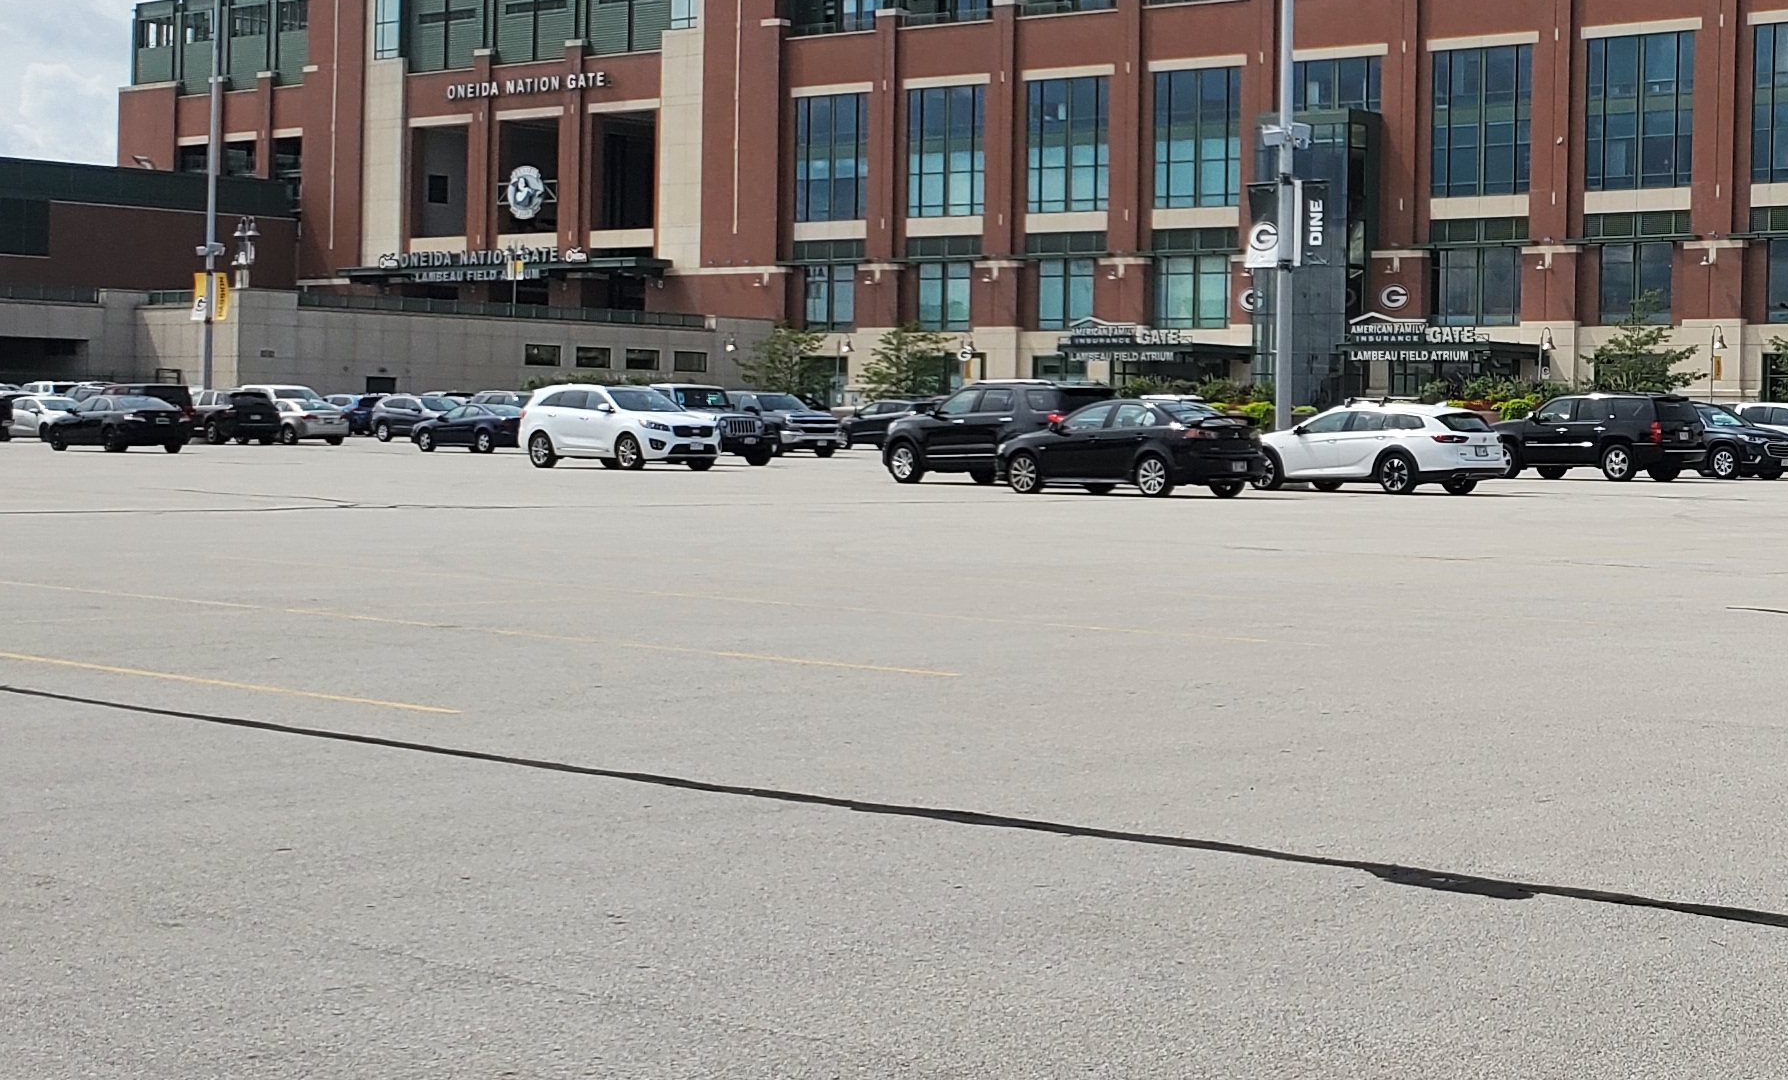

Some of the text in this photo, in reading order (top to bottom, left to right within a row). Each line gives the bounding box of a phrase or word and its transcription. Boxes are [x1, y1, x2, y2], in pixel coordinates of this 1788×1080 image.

[447, 72, 605, 100] ONEIDA NATION GATE
[1309, 199, 1324, 246] DINE
[401, 250, 451, 268] ONEIDA
[415, 271, 464, 282] LAMBEAU
[467, 270, 497, 282] FIELD
[1379, 285, 1410, 310] G
[1071, 327, 1108, 336] AMERICAN
[1137, 328, 1180, 345] GATE
[1351, 323, 1424, 334] AMERICAN FAMILY
[1428, 326, 1476, 344] GATE
[1071, 351, 1174, 361] LAMBEAU FIELD ATRIUM
[1351, 350, 1469, 361] LAMBEAU FIELD ATRIUM
